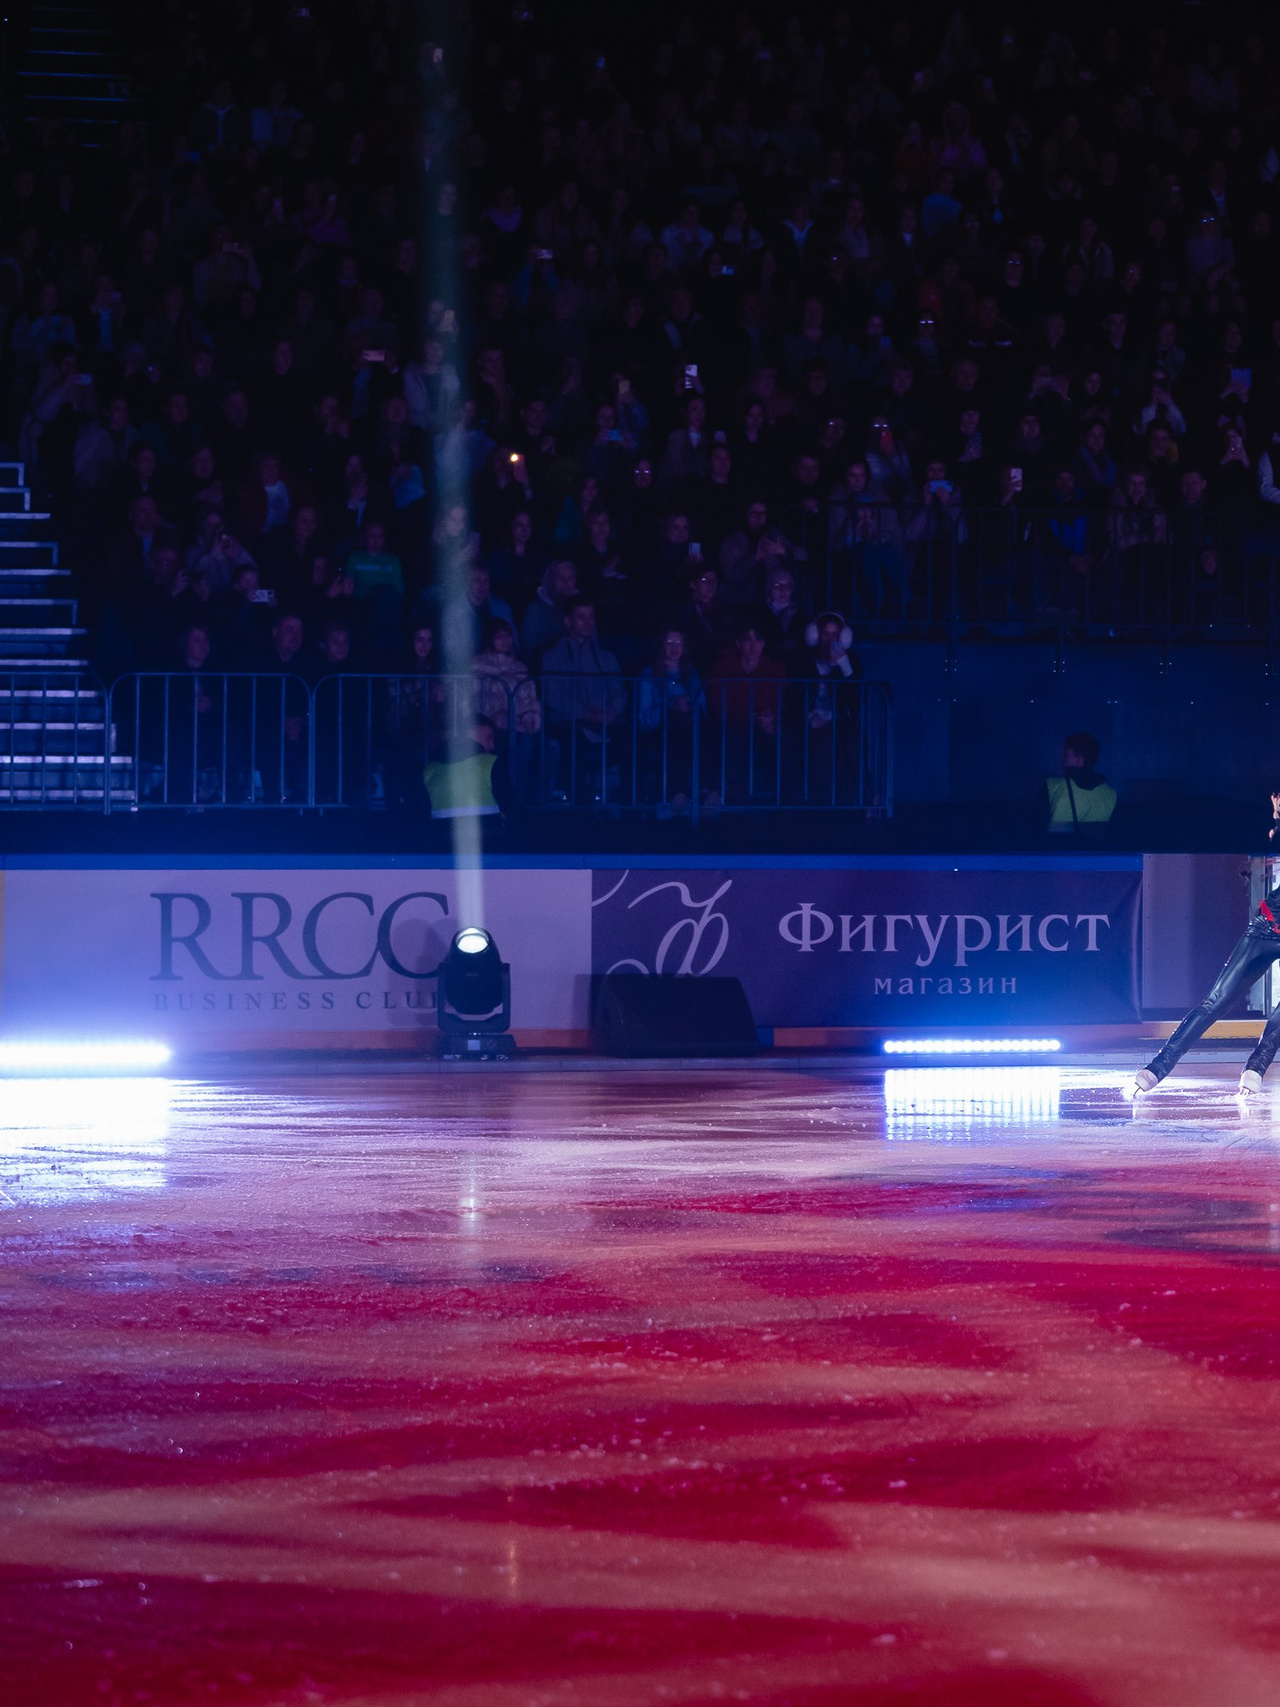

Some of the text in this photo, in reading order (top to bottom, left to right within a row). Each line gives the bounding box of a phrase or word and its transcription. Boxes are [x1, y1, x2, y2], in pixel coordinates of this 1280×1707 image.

[150, 892, 448, 979] RRCC
[779, 903, 1110, 967] Фигурист
[153, 993, 334, 1011] BUSINESS
[874, 976, 1017, 995] магазин
